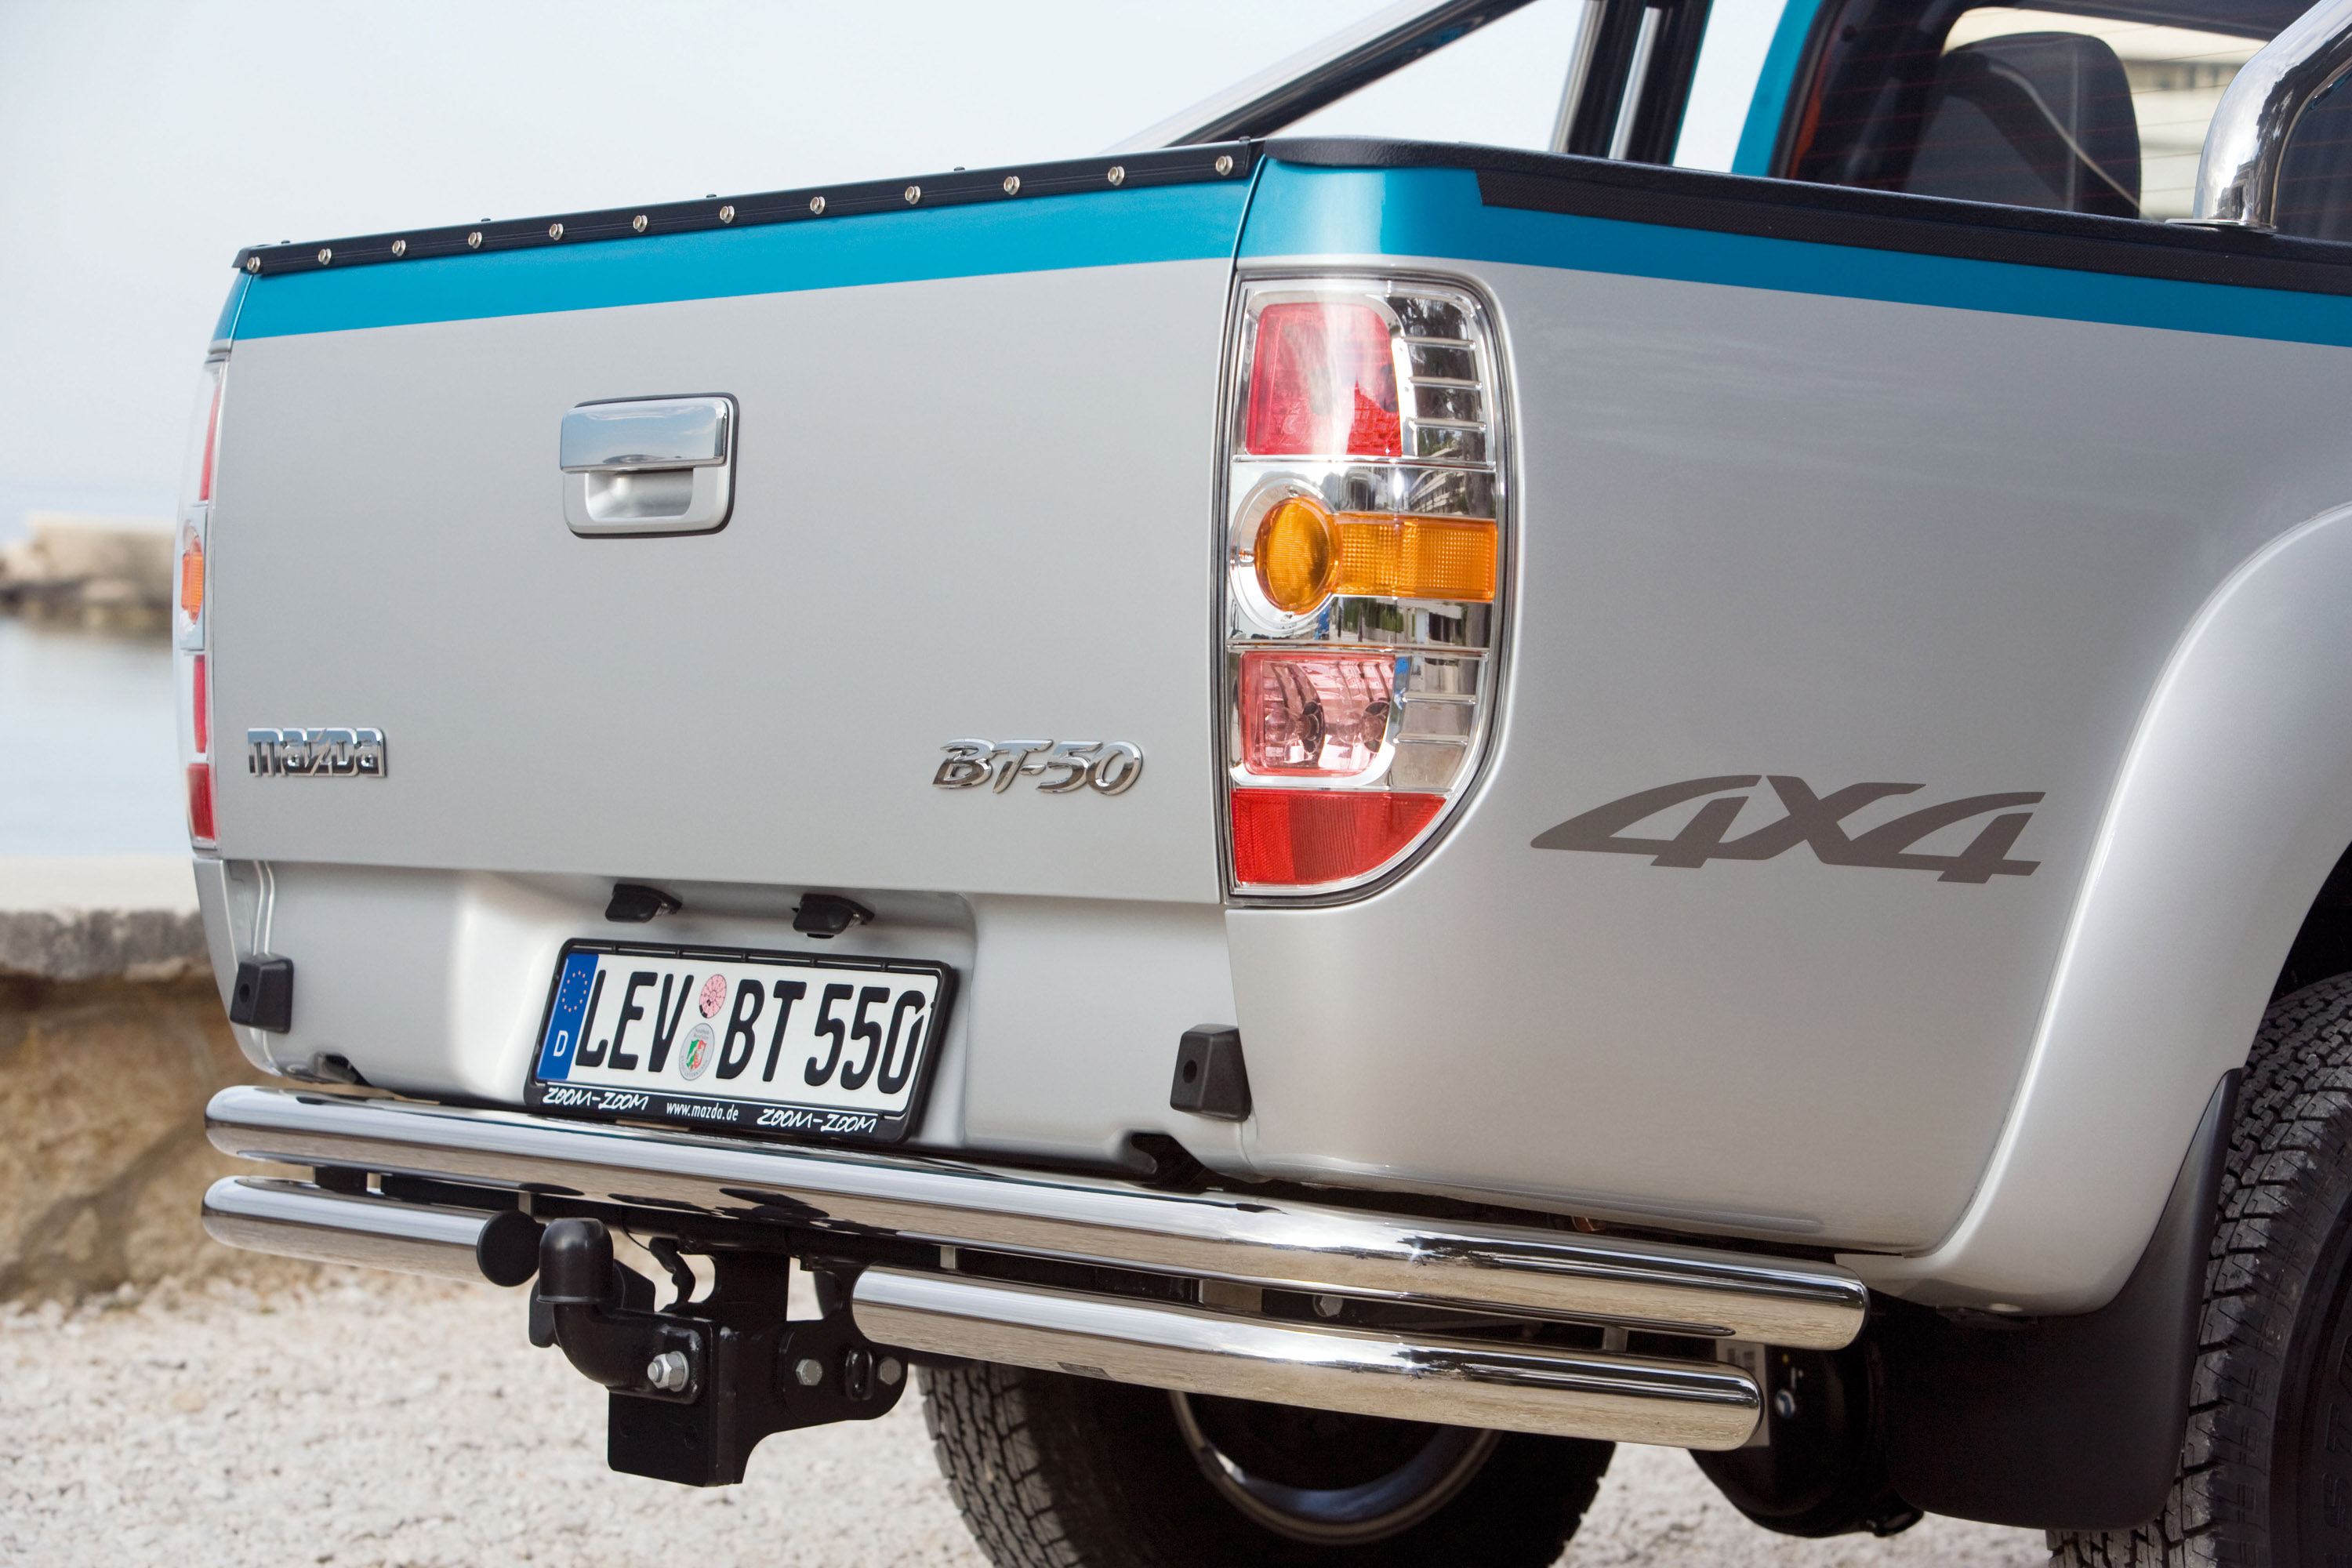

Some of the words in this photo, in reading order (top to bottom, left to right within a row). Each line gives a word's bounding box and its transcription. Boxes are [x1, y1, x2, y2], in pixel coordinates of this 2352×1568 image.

[932, 738, 1143, 796] BT-50
[553, 1030, 568, 1058] D
[575, 969, 694, 1073] LEV
[716, 979, 807, 1082] BT
[804, 983, 926, 1094] 550
[543, 1087, 649, 1111] ZOOM-ZOOM
[666, 1102, 739, 1121] www.mazda.de
[757, 1108, 877, 1133] ZOOM-ZOOM
